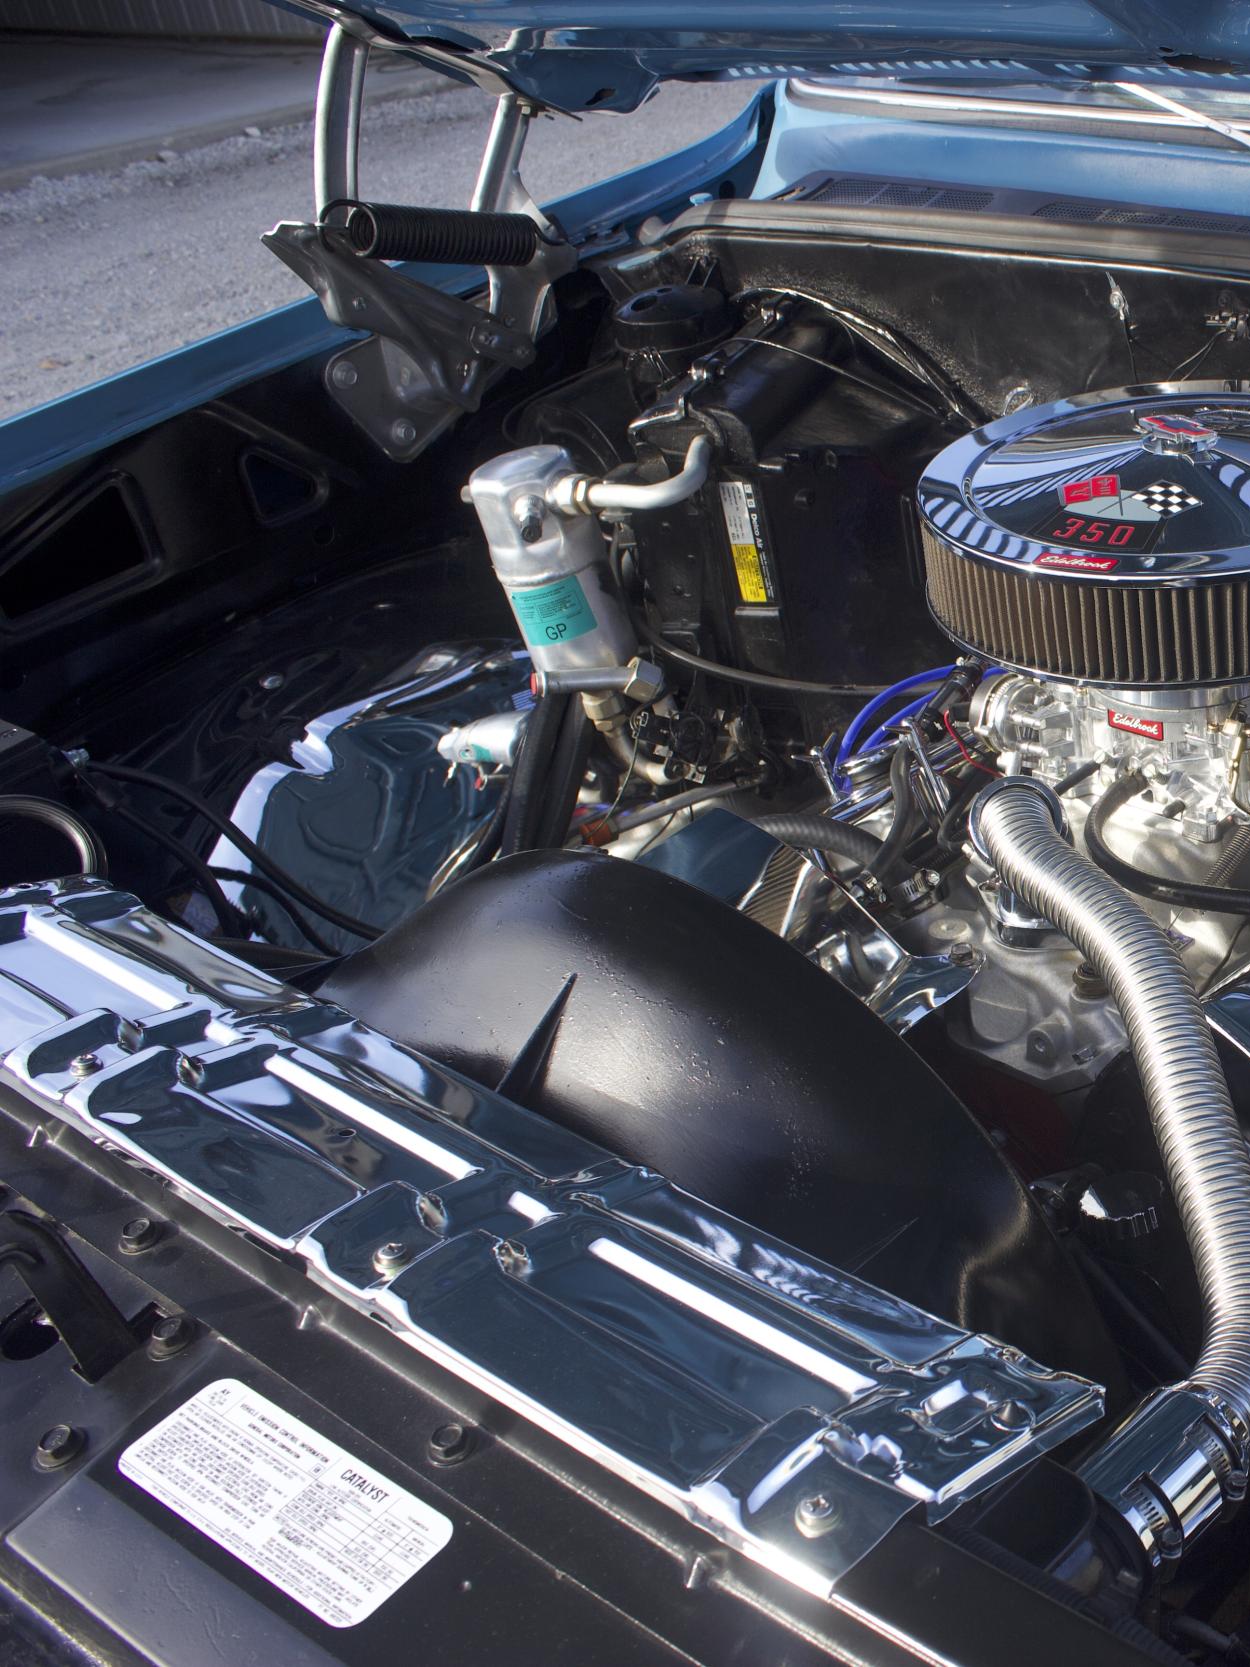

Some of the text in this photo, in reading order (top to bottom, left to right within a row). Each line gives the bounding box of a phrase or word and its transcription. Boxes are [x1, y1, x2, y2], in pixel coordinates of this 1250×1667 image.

[751, 513, 760, 538] Delco
[1052, 517, 1135, 546] 350
[1040, 555, 1111, 570] Edelbrock
[545, 622, 567, 641] GP
[1113, 712, 1159, 736] Edelbrock
[258, 1415, 280, 1430] EMISSION
[279, 1429, 299, 1442] CONTROL
[300, 1442, 330, 1463] INFORMATION
[339, 1468, 389, 1503] CATALYST
